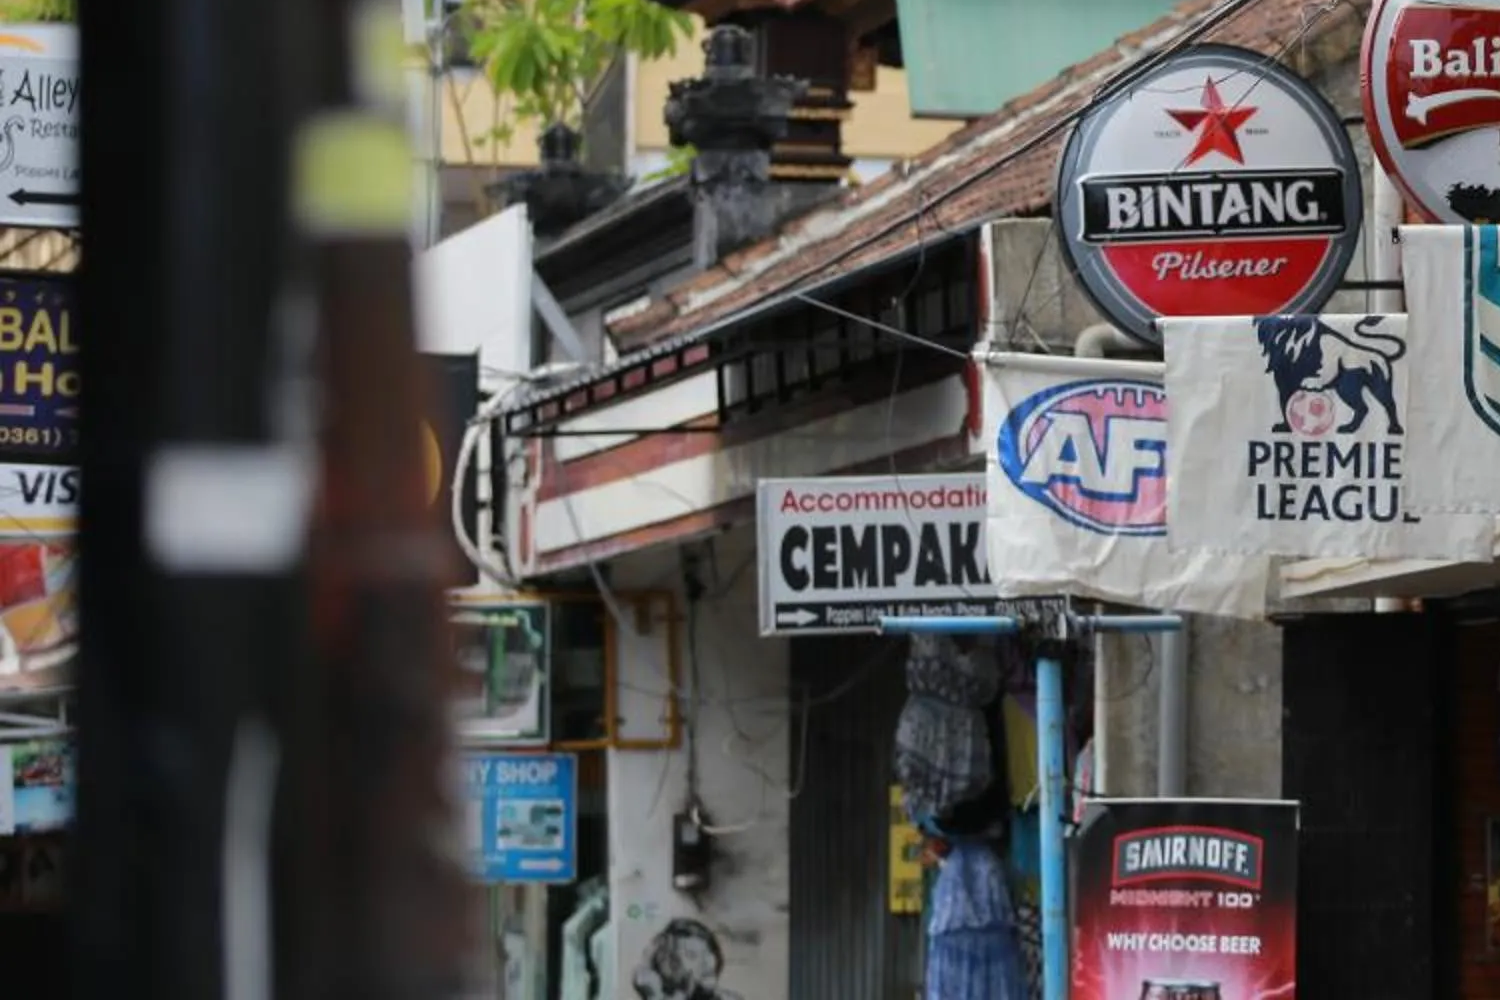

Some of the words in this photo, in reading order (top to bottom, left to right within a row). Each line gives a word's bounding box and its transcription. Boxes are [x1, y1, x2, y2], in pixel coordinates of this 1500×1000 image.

[11, 69, 79, 114] Alley
[1105, 181, 1319, 229] BINTANG
[1152, 251, 1288, 280] Pilsener
[1248, 441, 1403, 479] PREMIE
[1257, 483, 1421, 523] LEAGU
[780, 522, 992, 592] CEMPAK
[496, 760, 558, 785] SHOP
[1125, 835, 1249, 873] SMIRNOFF
[1108, 932, 1149, 950] WHY
[1150, 933, 1217, 951] CHOOSE
[1220, 935, 1261, 954] BEER
